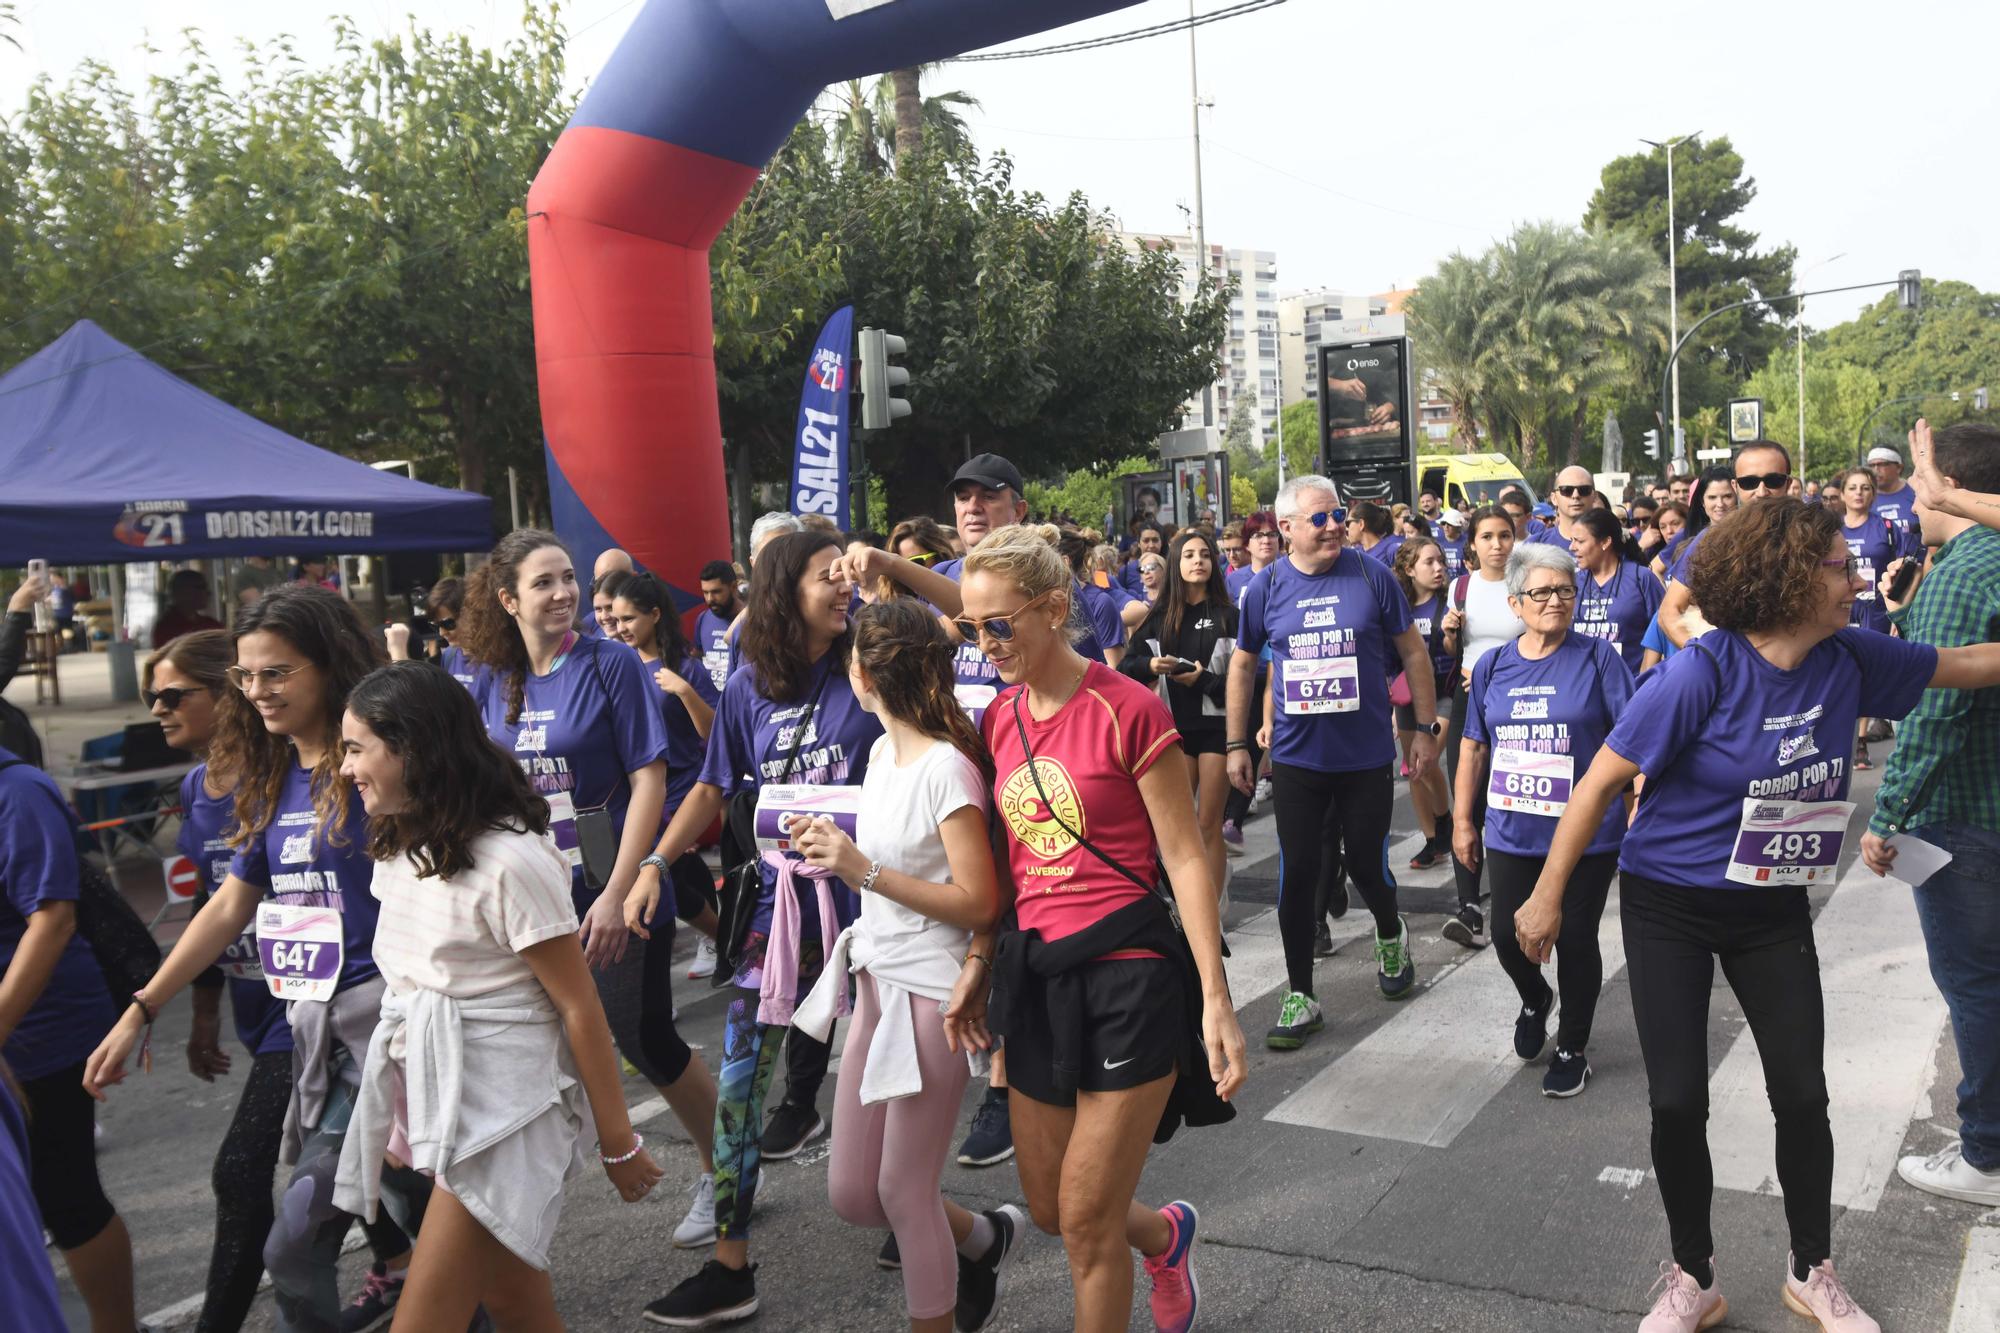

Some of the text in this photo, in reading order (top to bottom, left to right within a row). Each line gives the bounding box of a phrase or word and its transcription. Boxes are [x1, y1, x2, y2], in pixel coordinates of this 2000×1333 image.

[1359, 359, 1380, 368] enso
[141, 513, 183, 548] 21
[205, 511, 373, 539] DORSAL21.COM
[1288, 628, 1354, 648] CORRO POR TI
[1289, 646, 1319, 659] CORRO
[1321, 643, 1341, 657] POR
[958, 661, 979, 676] POR
[1300, 678, 1342, 698] 674
[1496, 723, 1568, 741] CORRO POR TI
[1530, 738, 1552, 753] POR
[555, 757, 568, 773] TI
[802, 748, 829, 769] POR
[829, 744, 843, 762] TI
[1505, 773, 1552, 797] 680
[1748, 757, 1844, 797] CORRO POR TI
[1042, 836, 1058, 853] 14
[1762, 833, 1821, 860] 493
[324, 871, 338, 892] TI
[272, 941, 321, 972] 647
